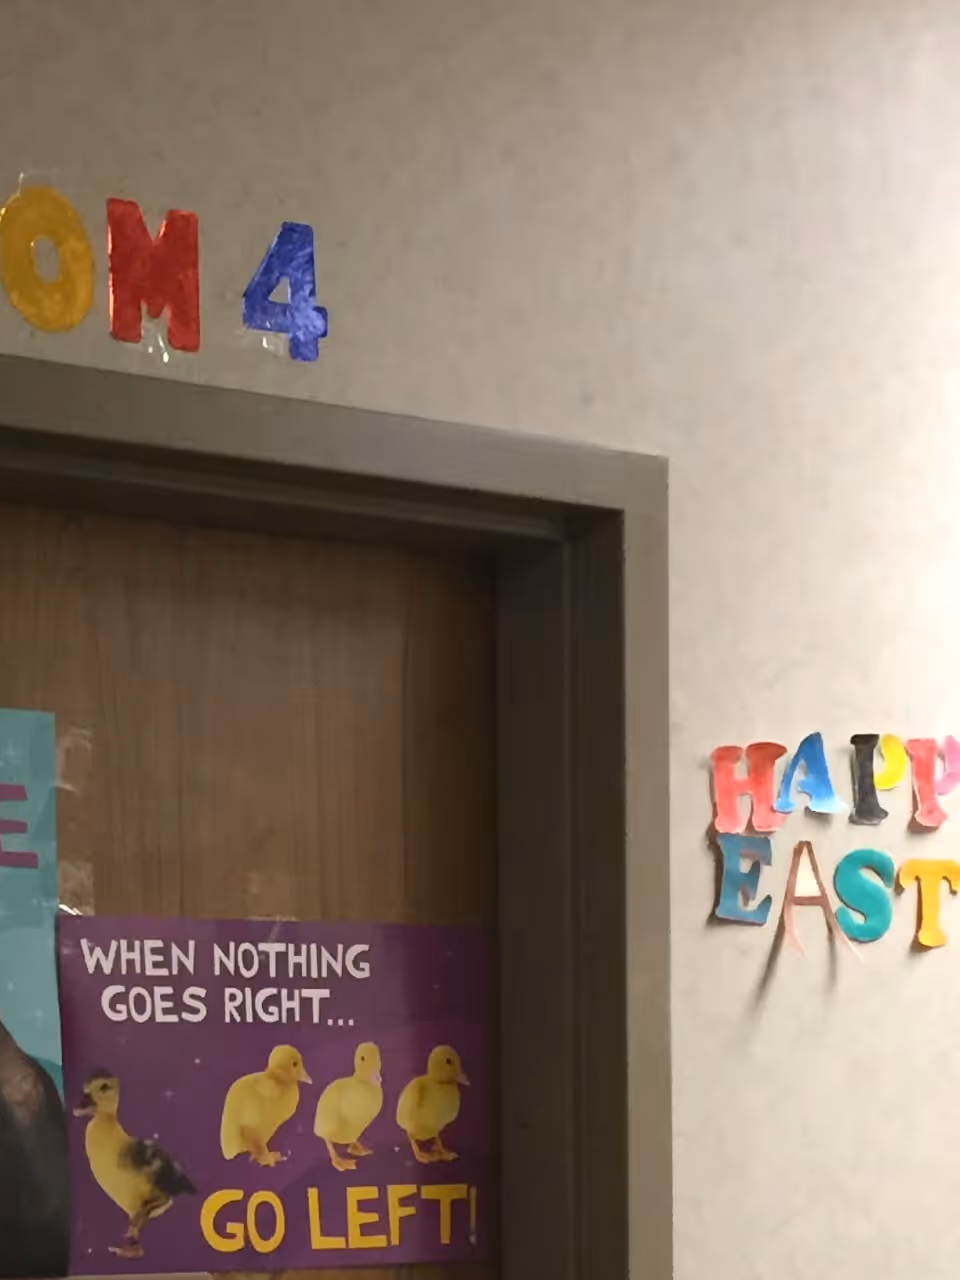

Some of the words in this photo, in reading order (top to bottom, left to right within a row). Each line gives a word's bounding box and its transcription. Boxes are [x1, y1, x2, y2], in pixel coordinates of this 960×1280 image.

[242, 221, 328, 362] 4
[715, 831, 960, 961] EAST
[80, 938, 195, 976] WHEN
[213, 941, 371, 979] NOTHING
[101, 985, 207, 1023] GOES
[224, 987, 355, 1026] RIGHT...
[200, 1188, 285, 1253] GO
[307, 1183, 477, 1250] LEFT!
